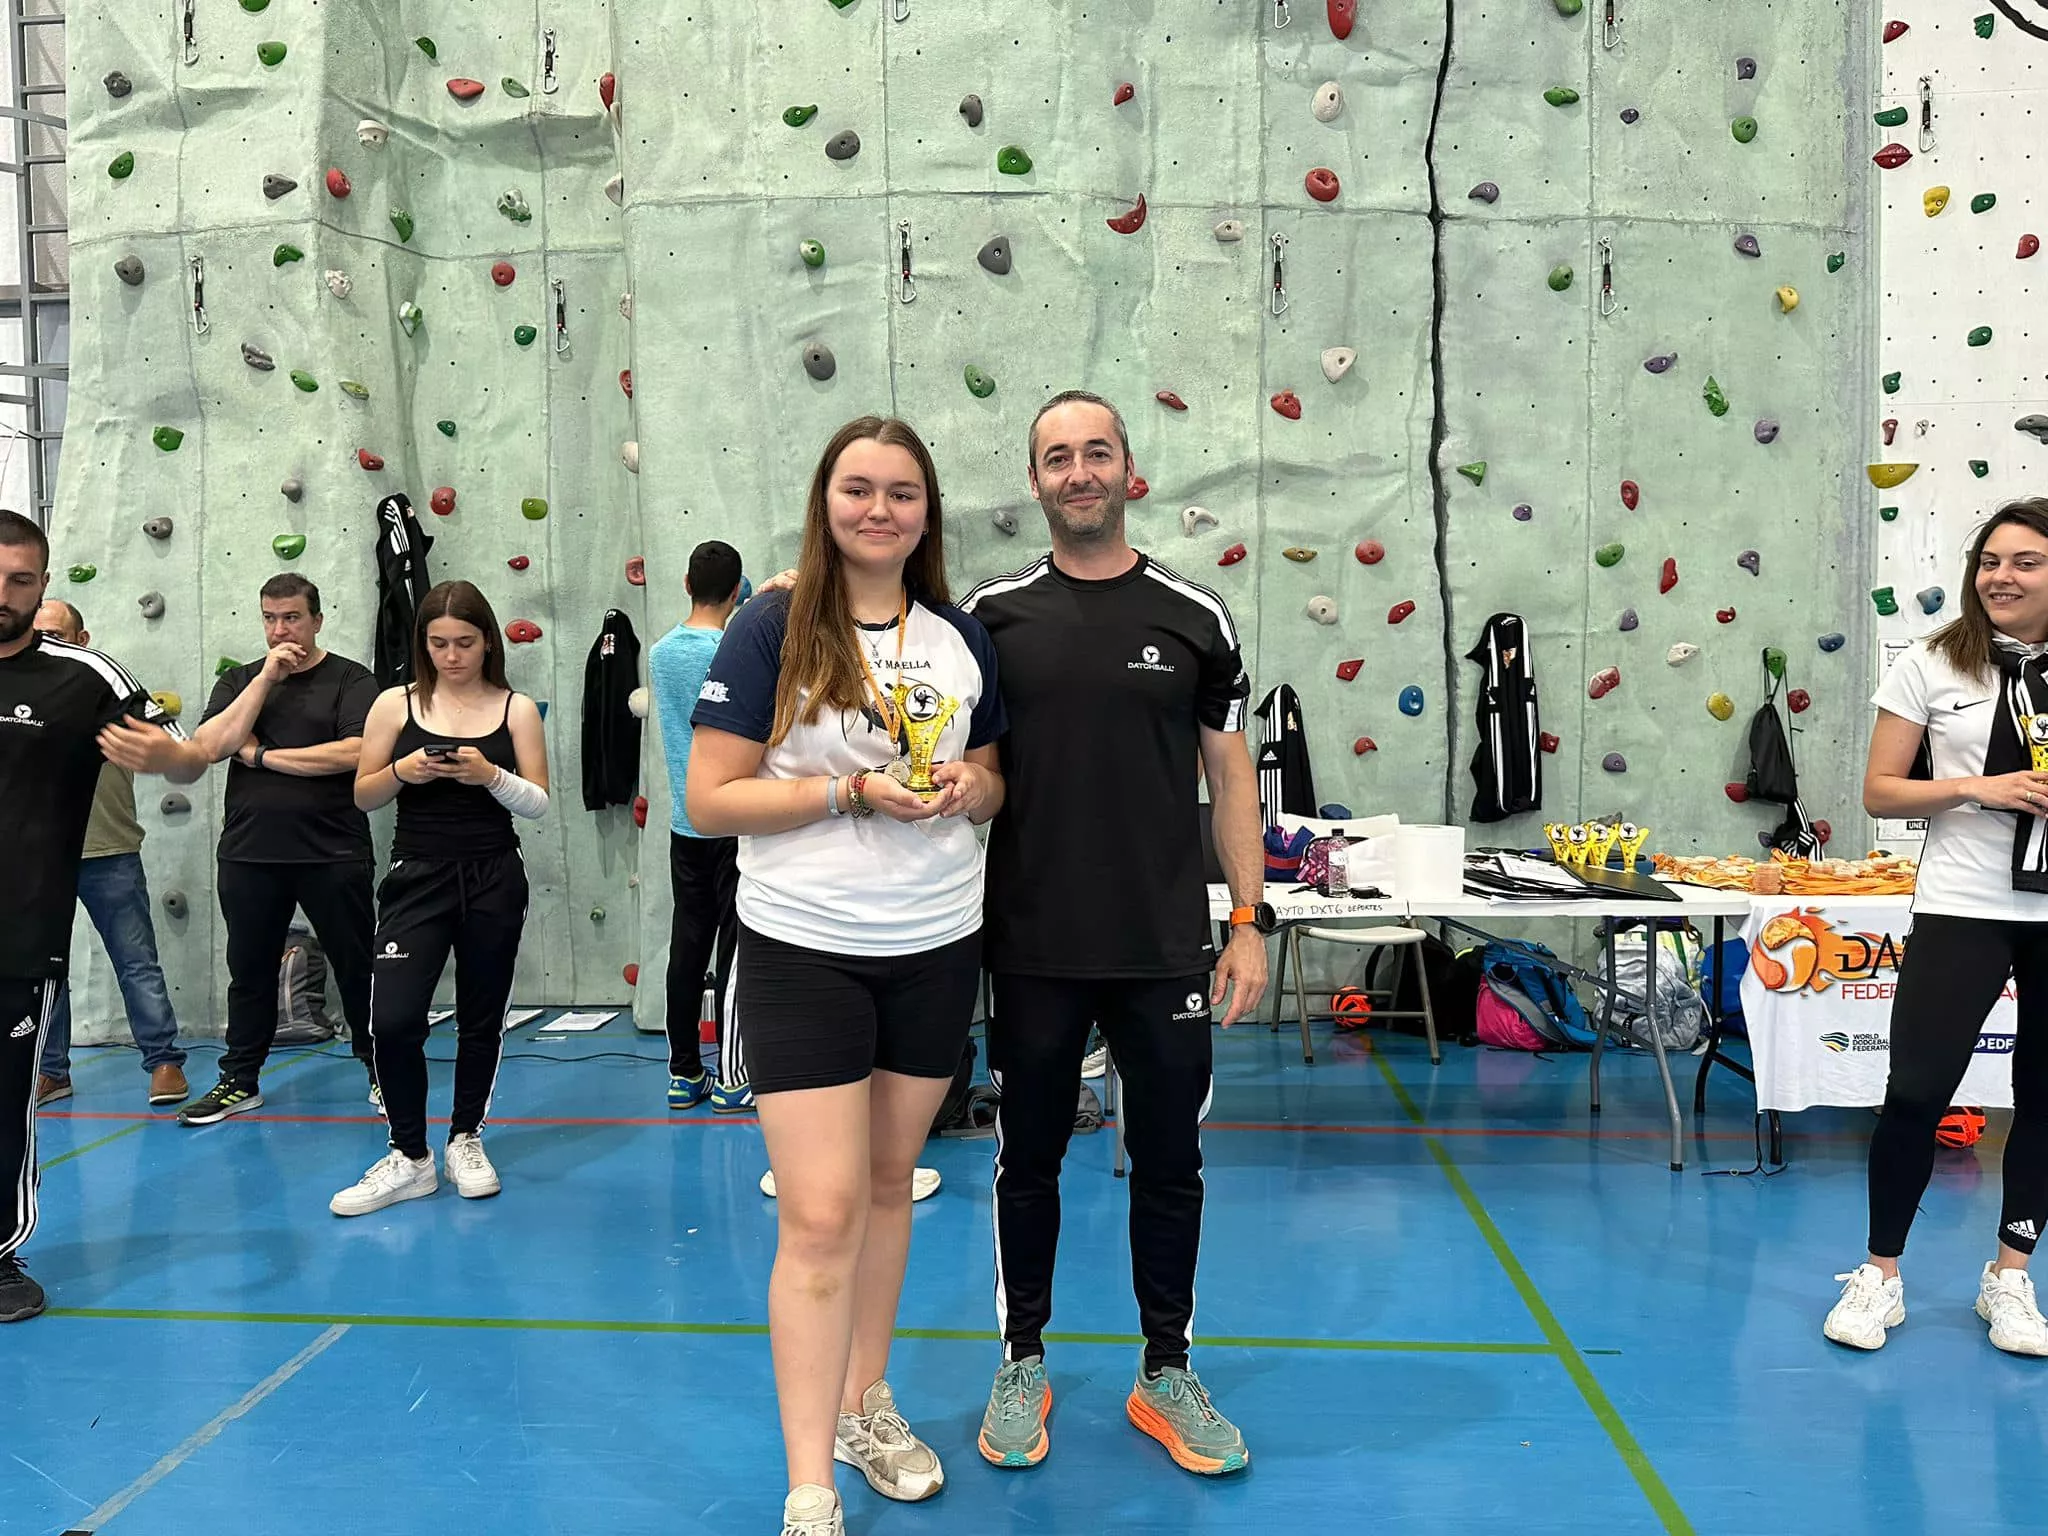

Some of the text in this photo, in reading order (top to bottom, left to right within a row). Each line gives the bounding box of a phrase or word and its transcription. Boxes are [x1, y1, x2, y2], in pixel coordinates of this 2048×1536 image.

[885, 660, 932, 670] MAELLA
[1834, 932, 1908, 979] DA
[1853, 1044, 1890, 1052] FEDERATIO
[1987, 1037, 2015, 1050] EDF
